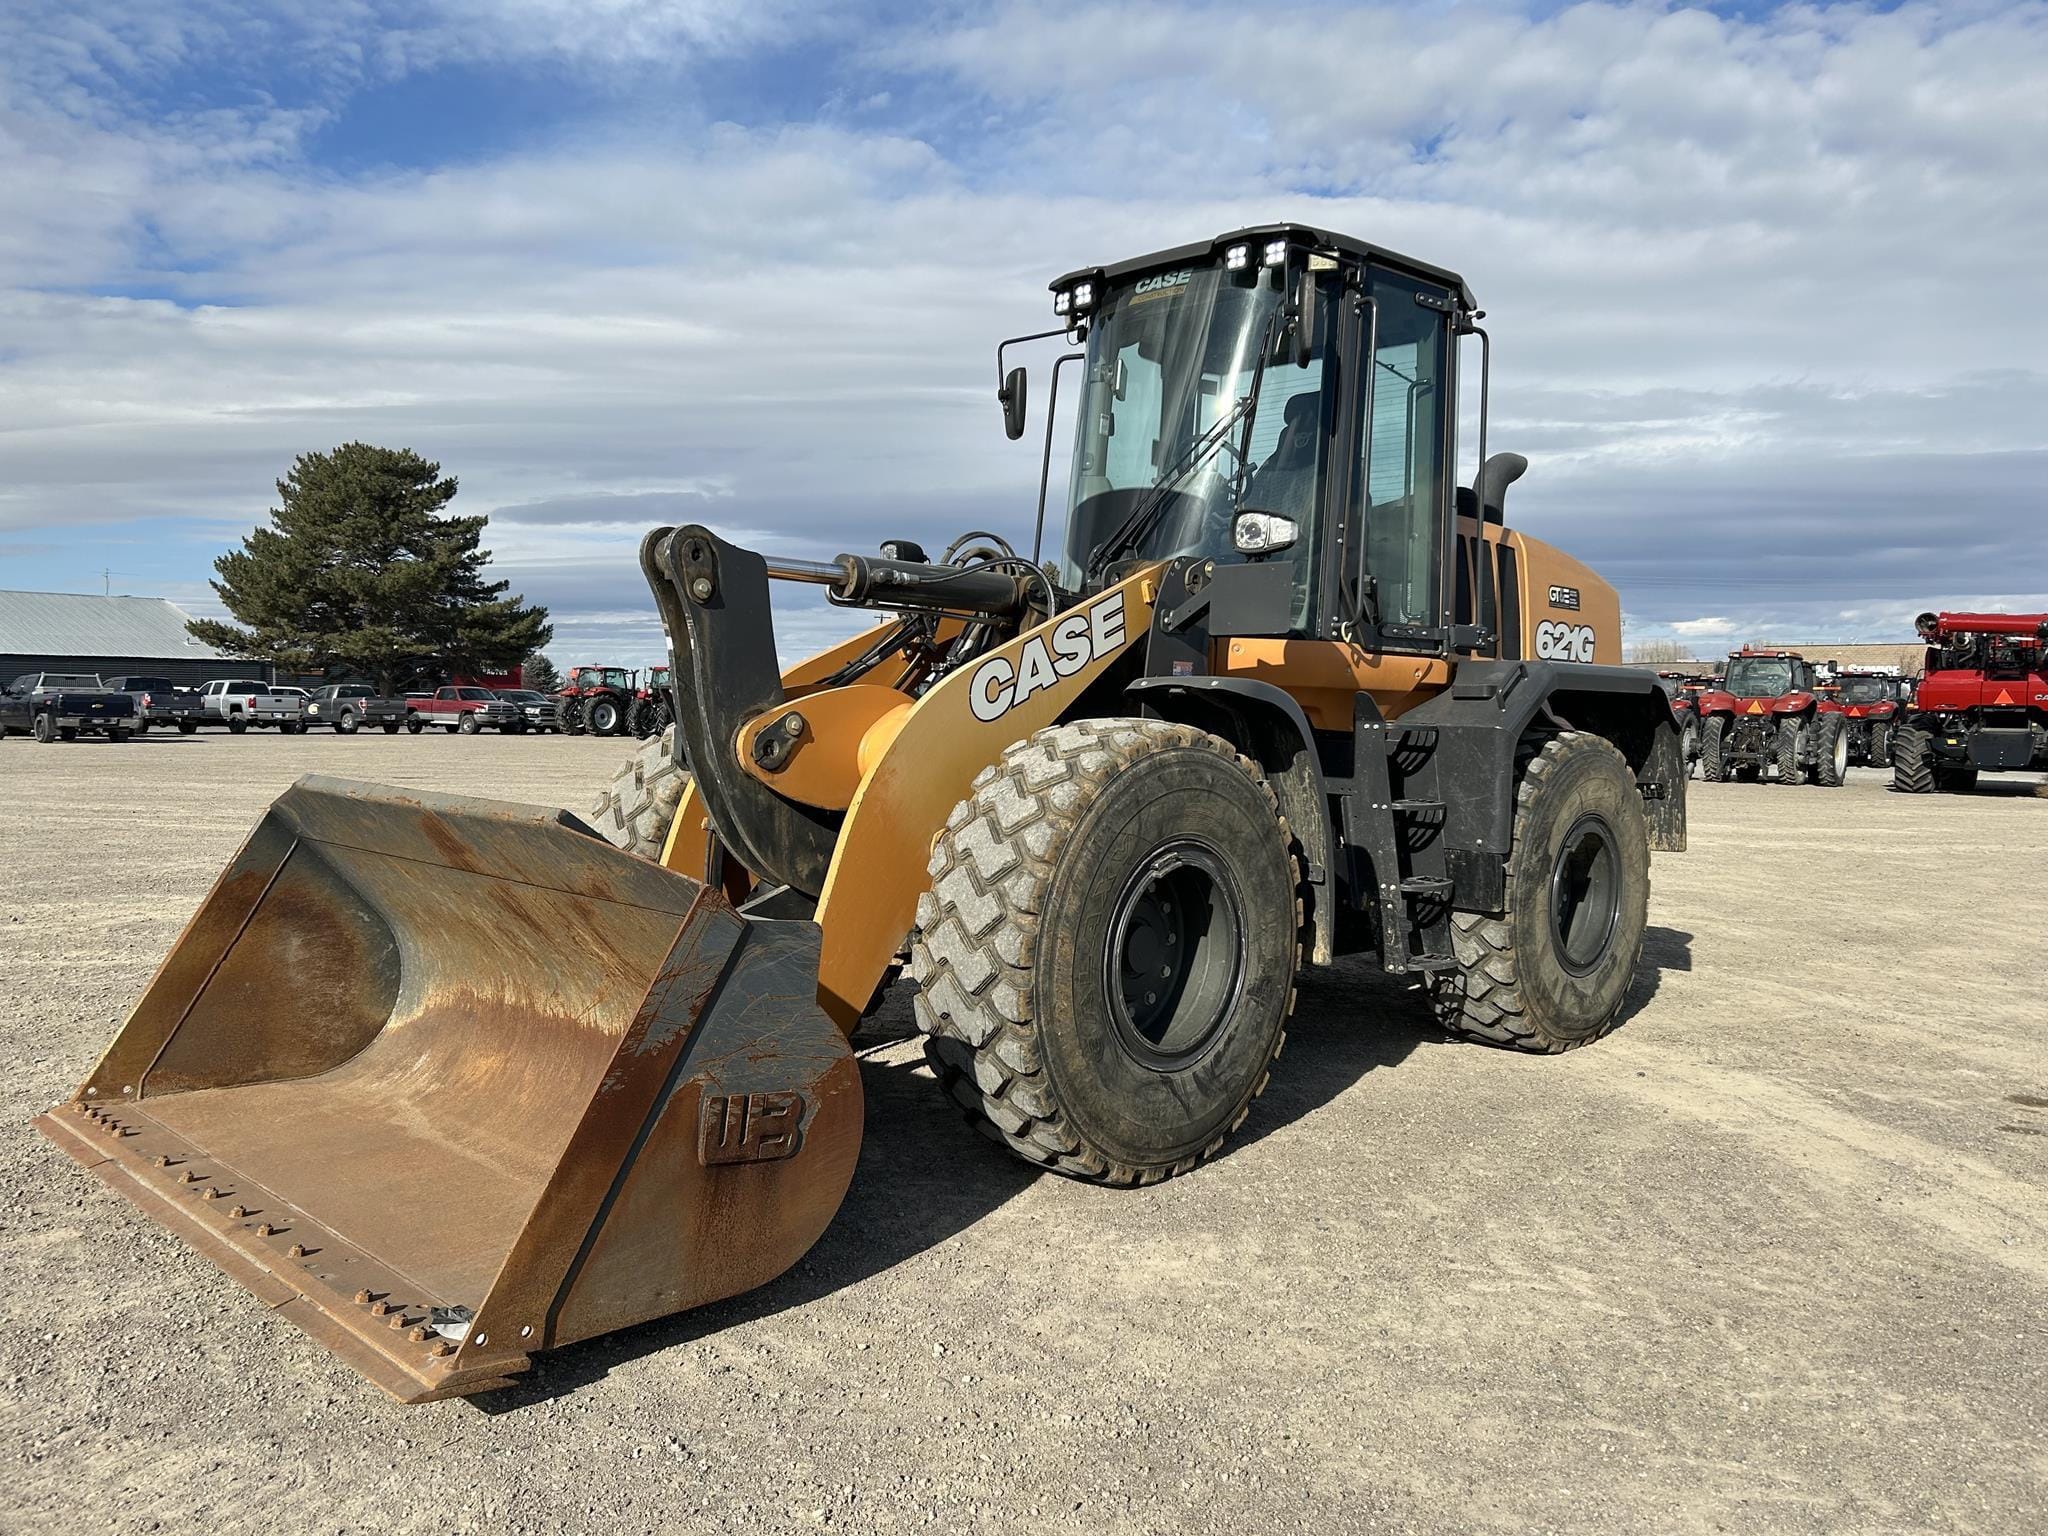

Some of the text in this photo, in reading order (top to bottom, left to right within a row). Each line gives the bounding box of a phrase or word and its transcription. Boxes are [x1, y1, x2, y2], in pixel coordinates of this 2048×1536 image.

[1135, 268, 1193, 294] CASE
[969, 590, 1127, 722] CASE
[1535, 619, 1595, 664] 621G
